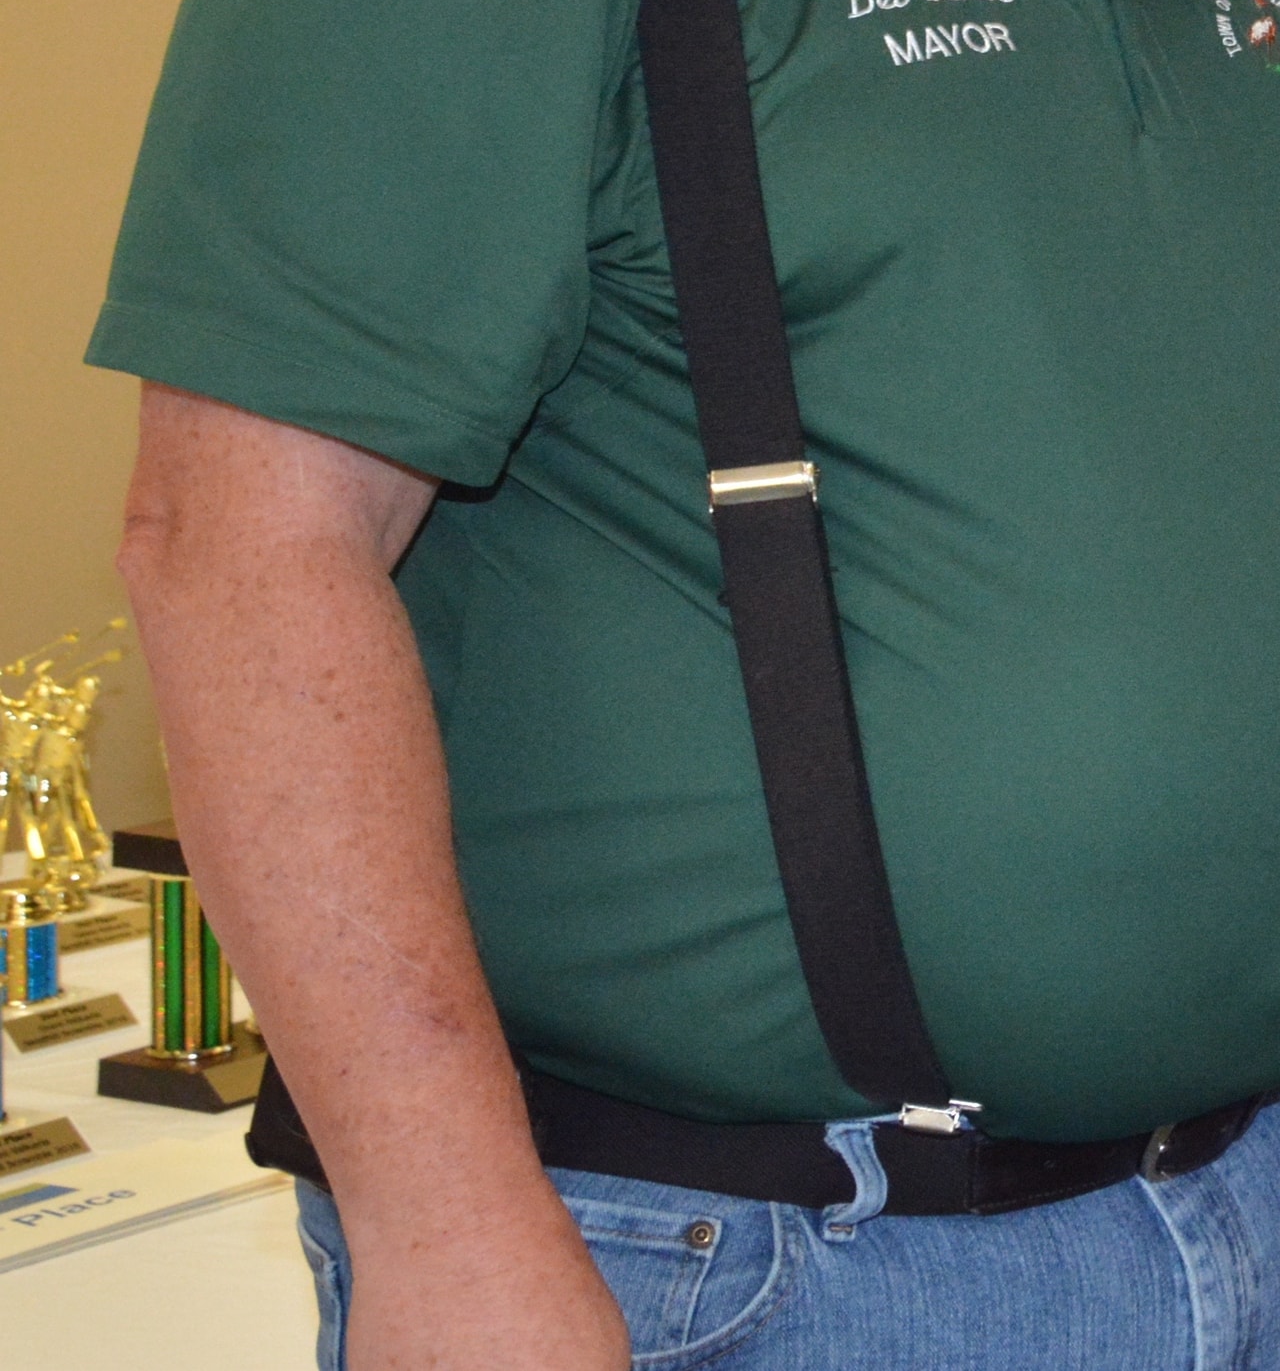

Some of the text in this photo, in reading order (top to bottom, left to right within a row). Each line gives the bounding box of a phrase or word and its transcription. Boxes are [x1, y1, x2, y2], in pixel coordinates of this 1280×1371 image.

[883, 21, 1017, 67] MAYOR
[1215, 13, 1243, 58] TOWN
[11, 1189, 137, 1227] Place
